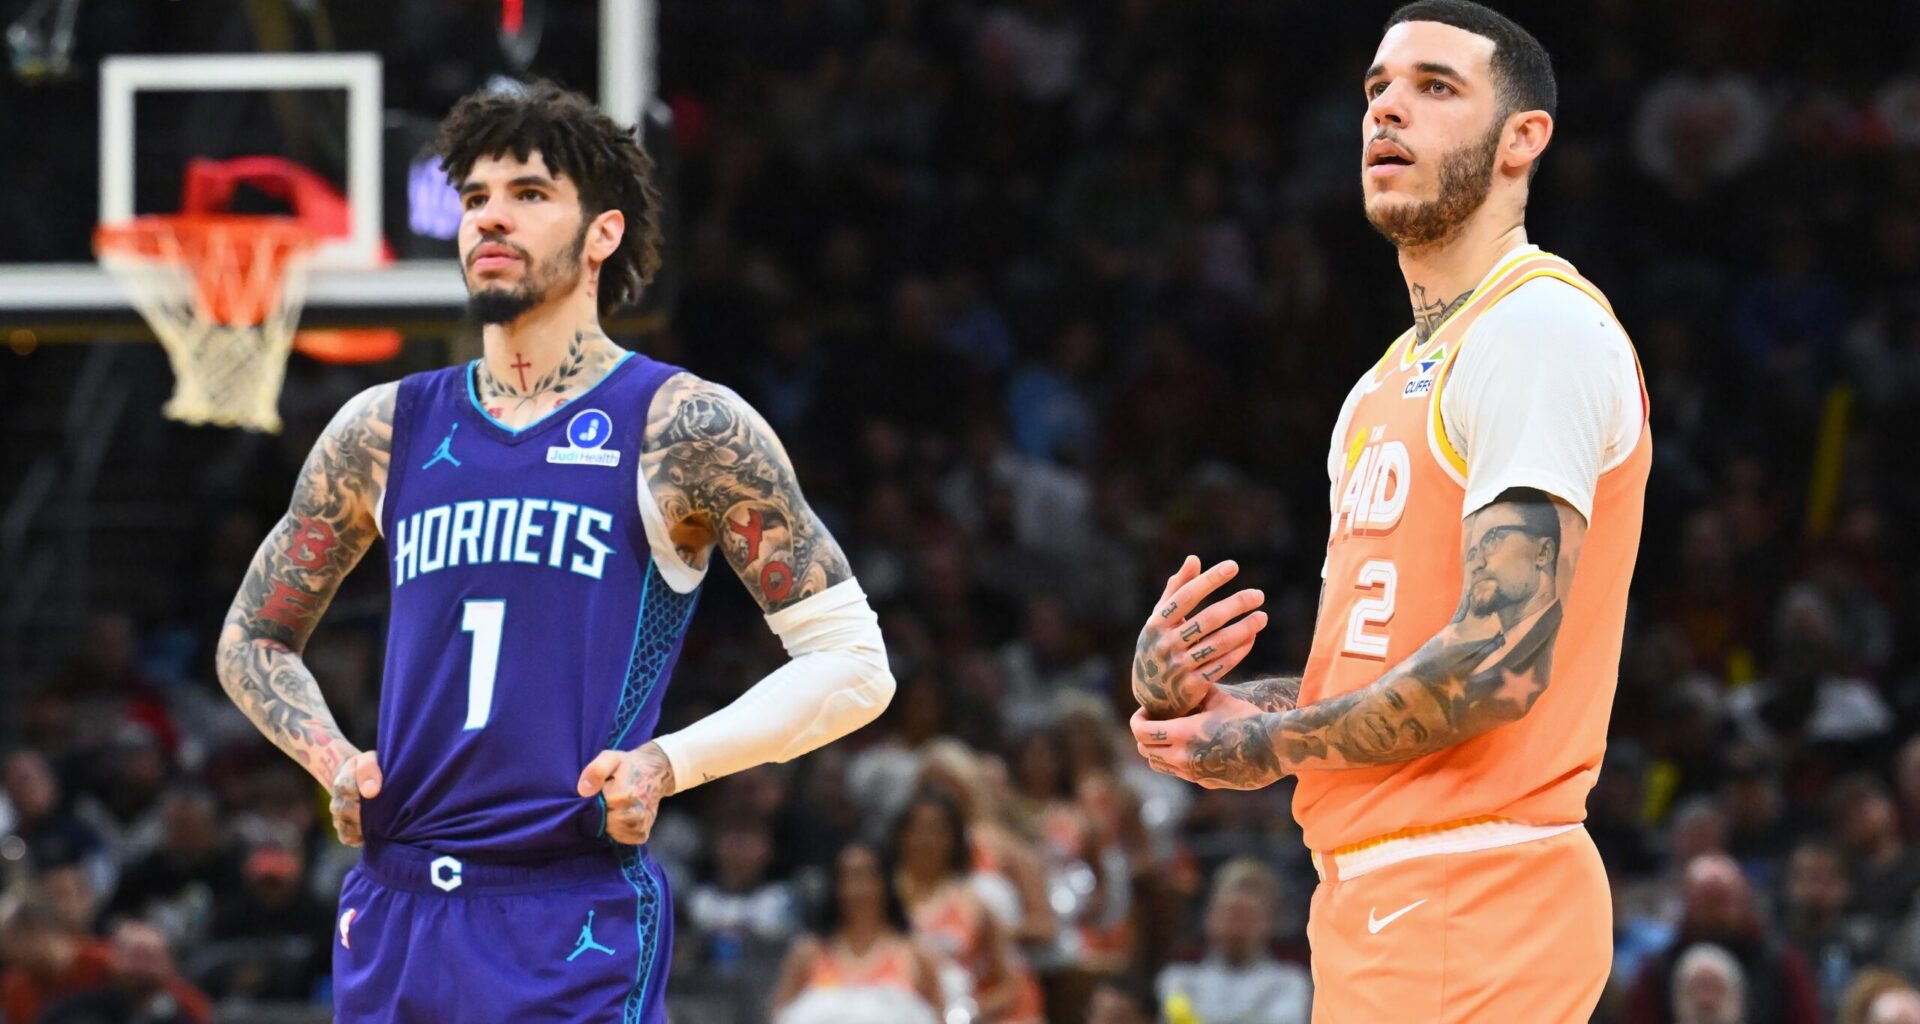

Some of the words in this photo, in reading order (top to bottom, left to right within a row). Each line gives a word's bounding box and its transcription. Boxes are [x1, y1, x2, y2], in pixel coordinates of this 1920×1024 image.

[580, 451, 619, 465] Health
[394, 498, 617, 588] HORNETS
[1342, 559, 1397, 661] 2
[461, 599, 506, 730] 1
